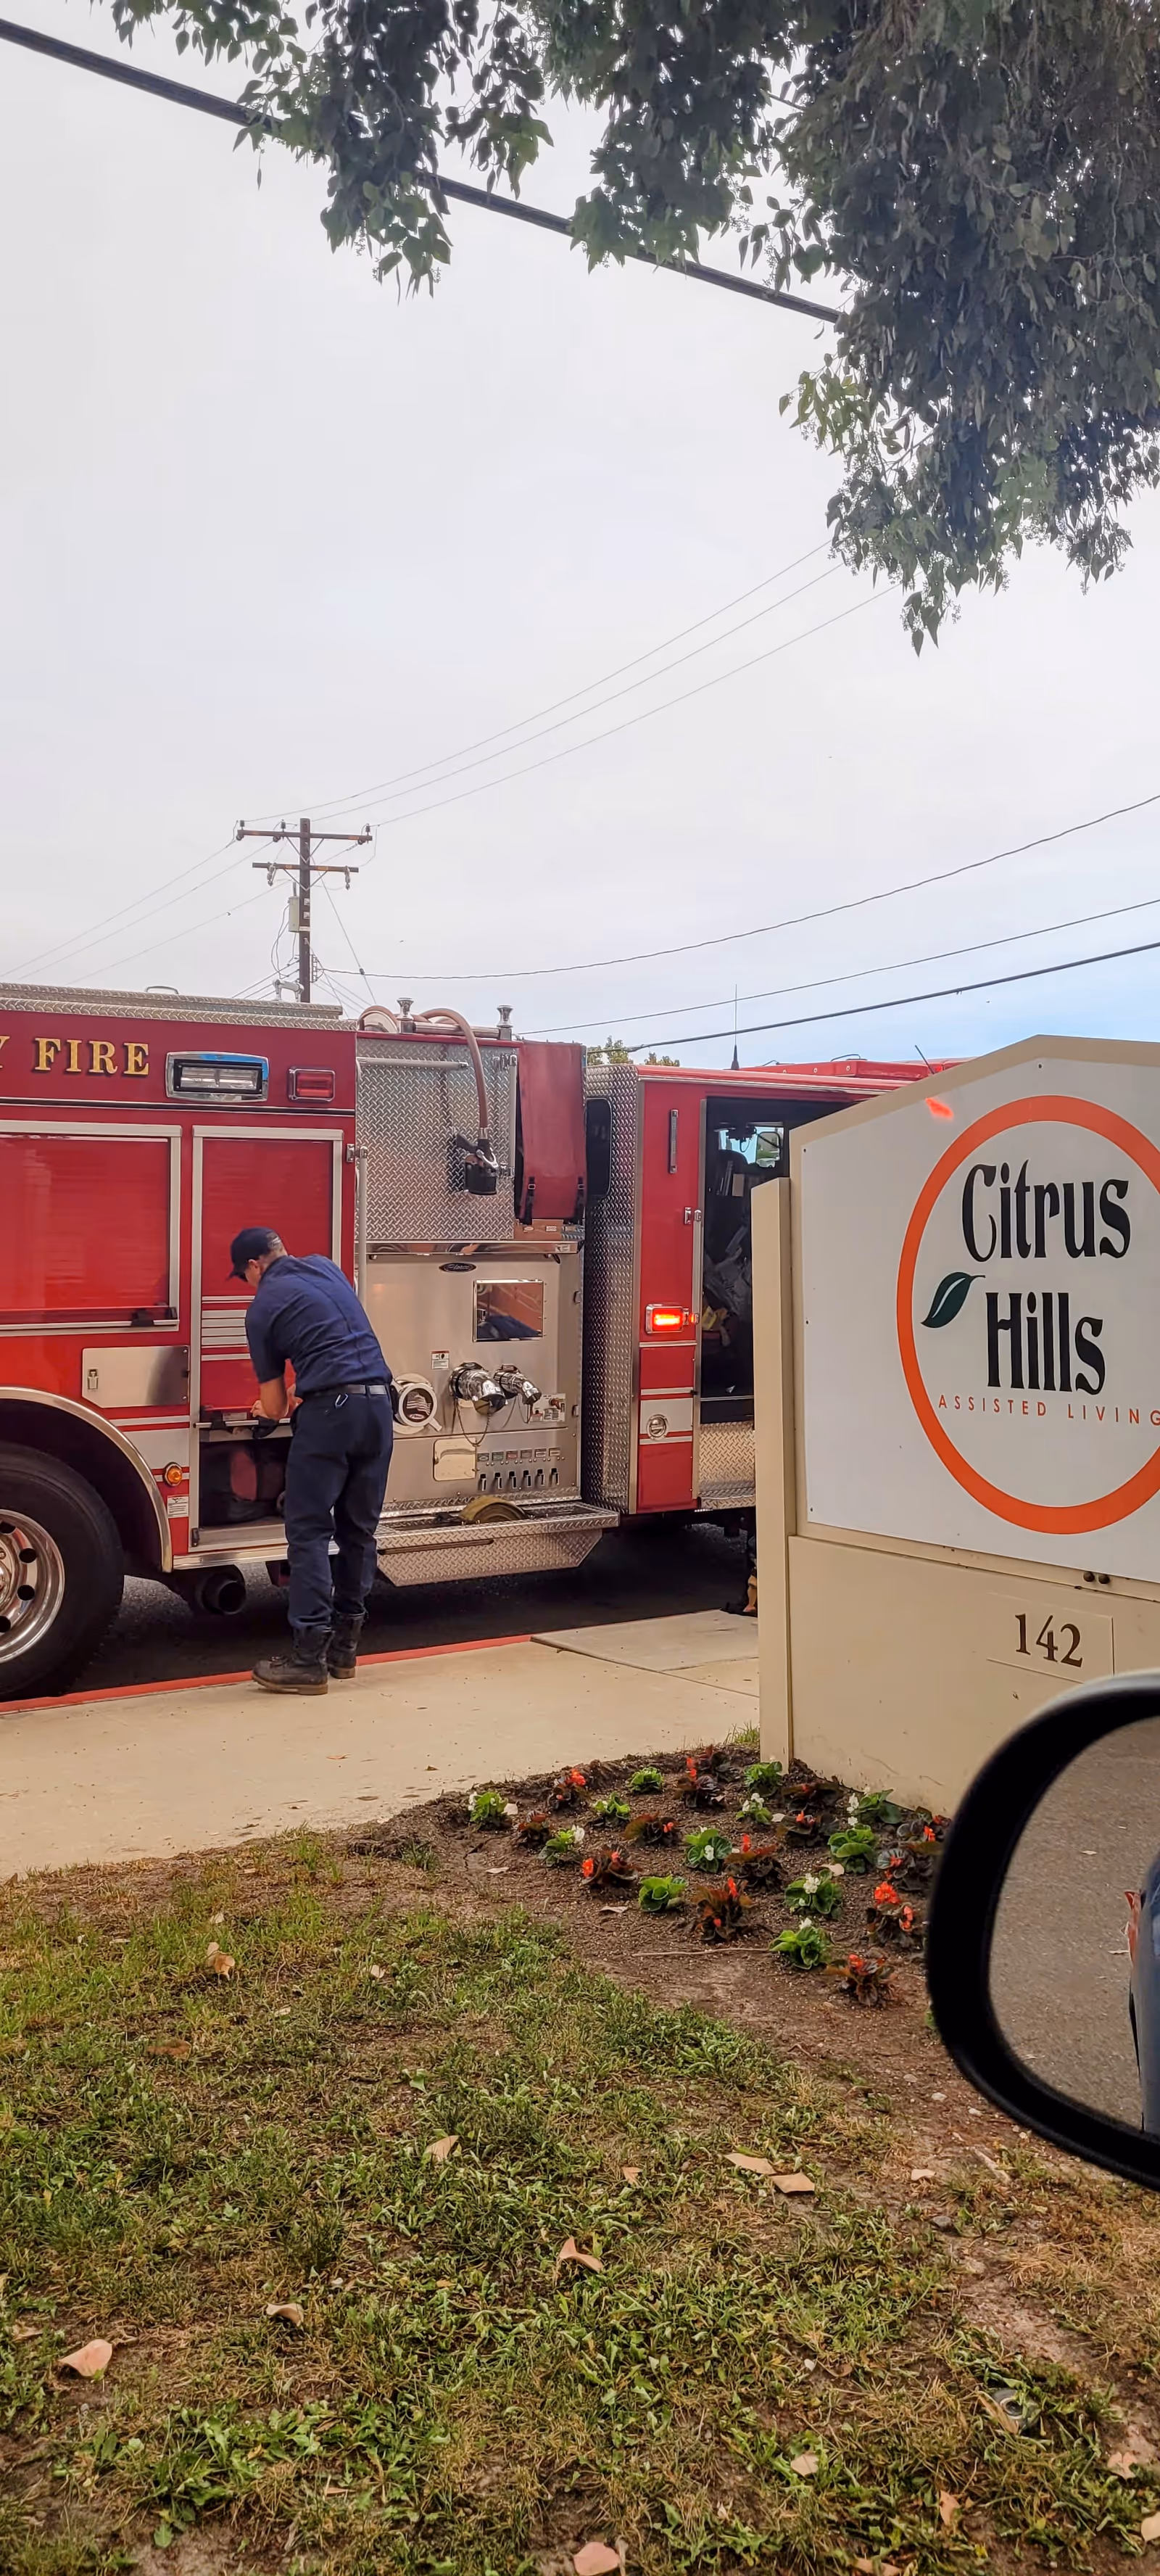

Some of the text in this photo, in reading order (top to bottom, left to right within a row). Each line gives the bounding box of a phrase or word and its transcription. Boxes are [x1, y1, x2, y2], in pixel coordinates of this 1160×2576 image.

[34, 1037, 149, 1076] FIRE
[961, 1159, 1131, 1263] Citrus
[985, 1291, 1106, 1395] Hills
[938, 1395, 1160, 1427] ASSISTED LIVING
[1014, 1613, 1084, 1668] 142
